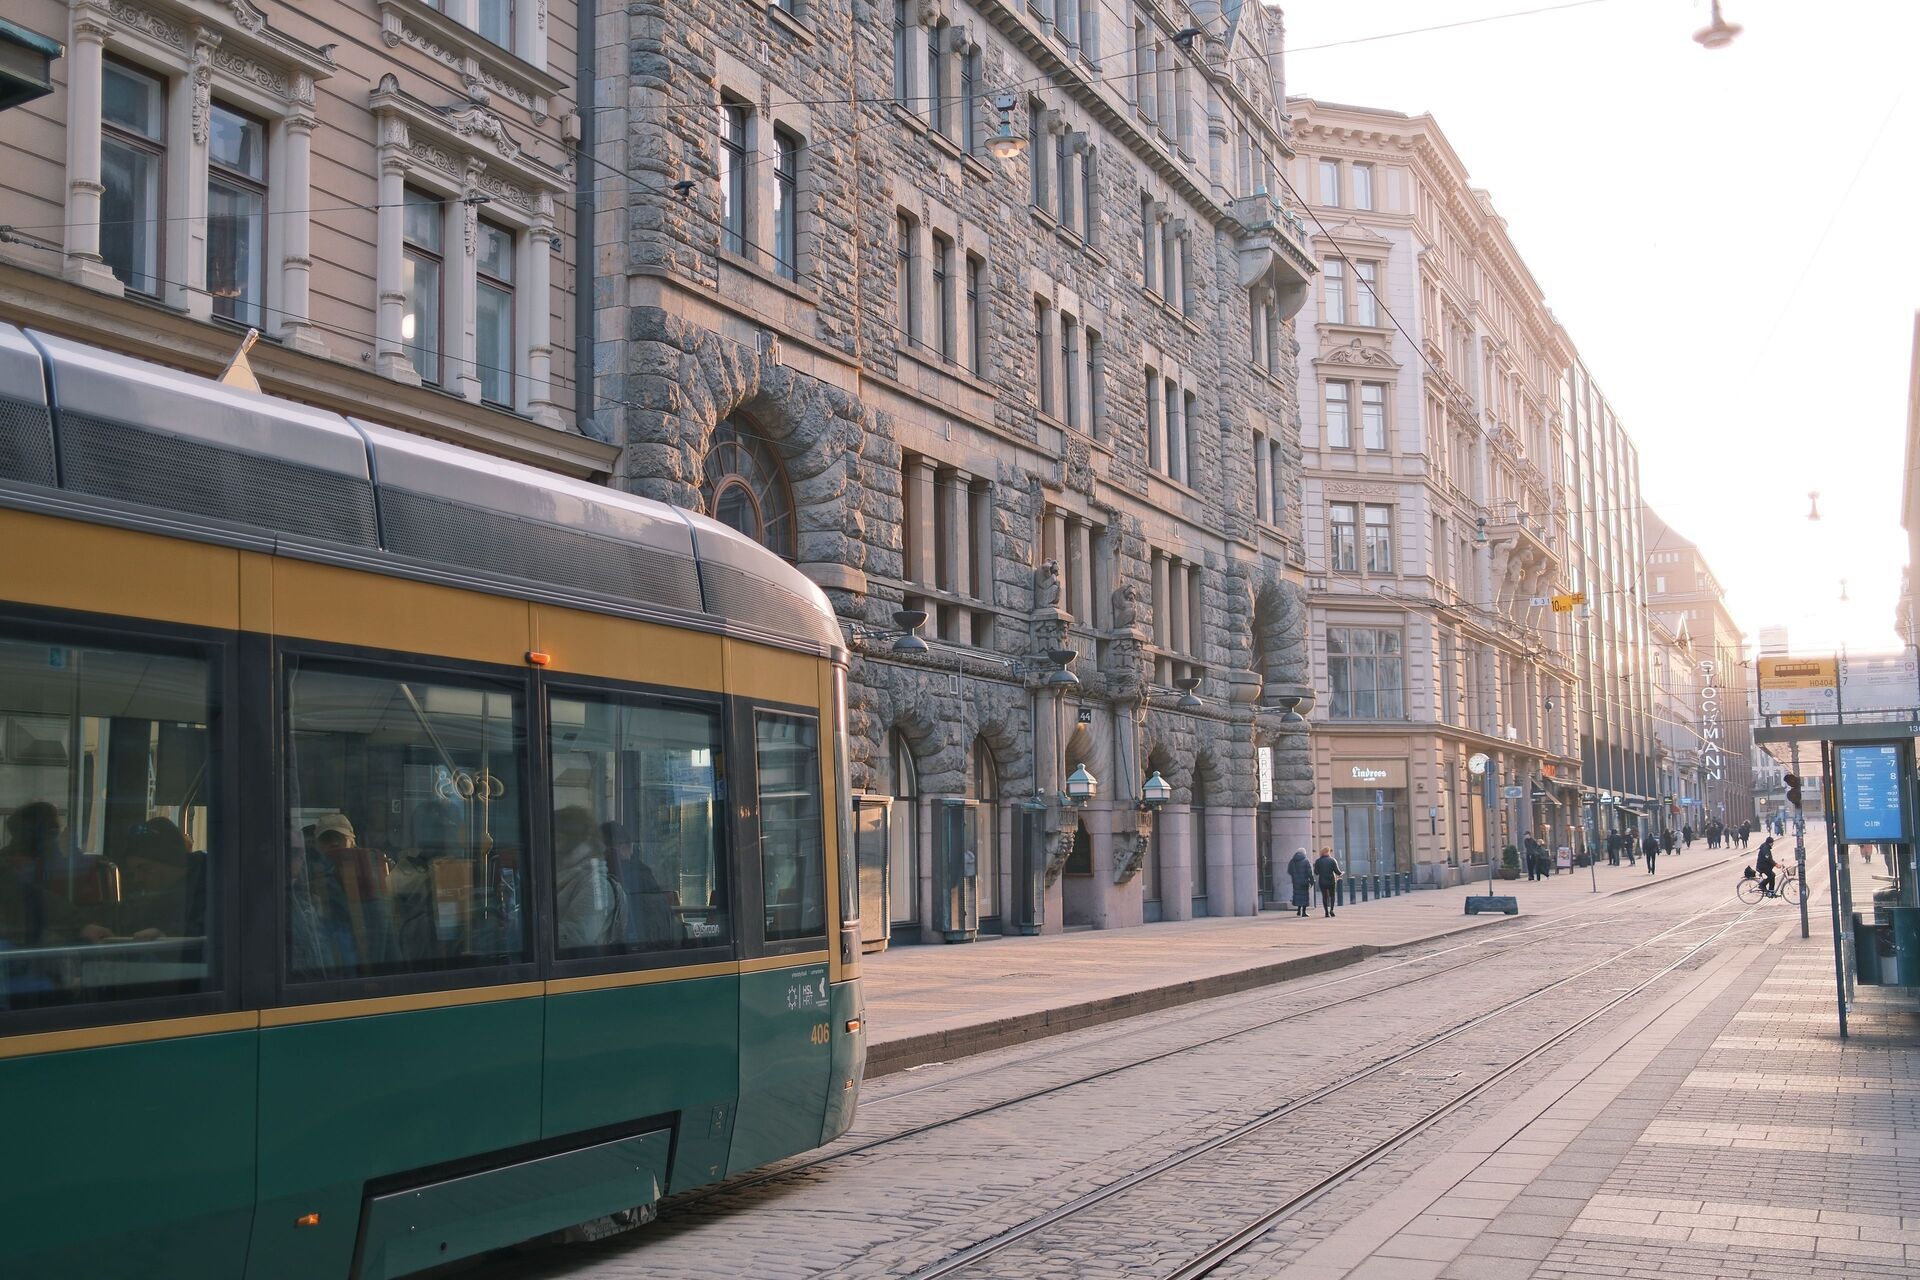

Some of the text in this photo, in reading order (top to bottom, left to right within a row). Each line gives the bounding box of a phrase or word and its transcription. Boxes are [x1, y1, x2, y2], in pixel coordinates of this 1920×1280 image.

[1842, 677, 1848, 685] 7
[1764, 702, 1770, 711] 2
[1080, 712, 1090, 721] 44
[1700, 660, 1721, 780] STOCKMANN
[1261, 749, 1269, 800] ARKET
[1890, 772, 1896, 780] 8
[802, 984, 813, 995] HSL
[811, 1022, 830, 1045] 406
